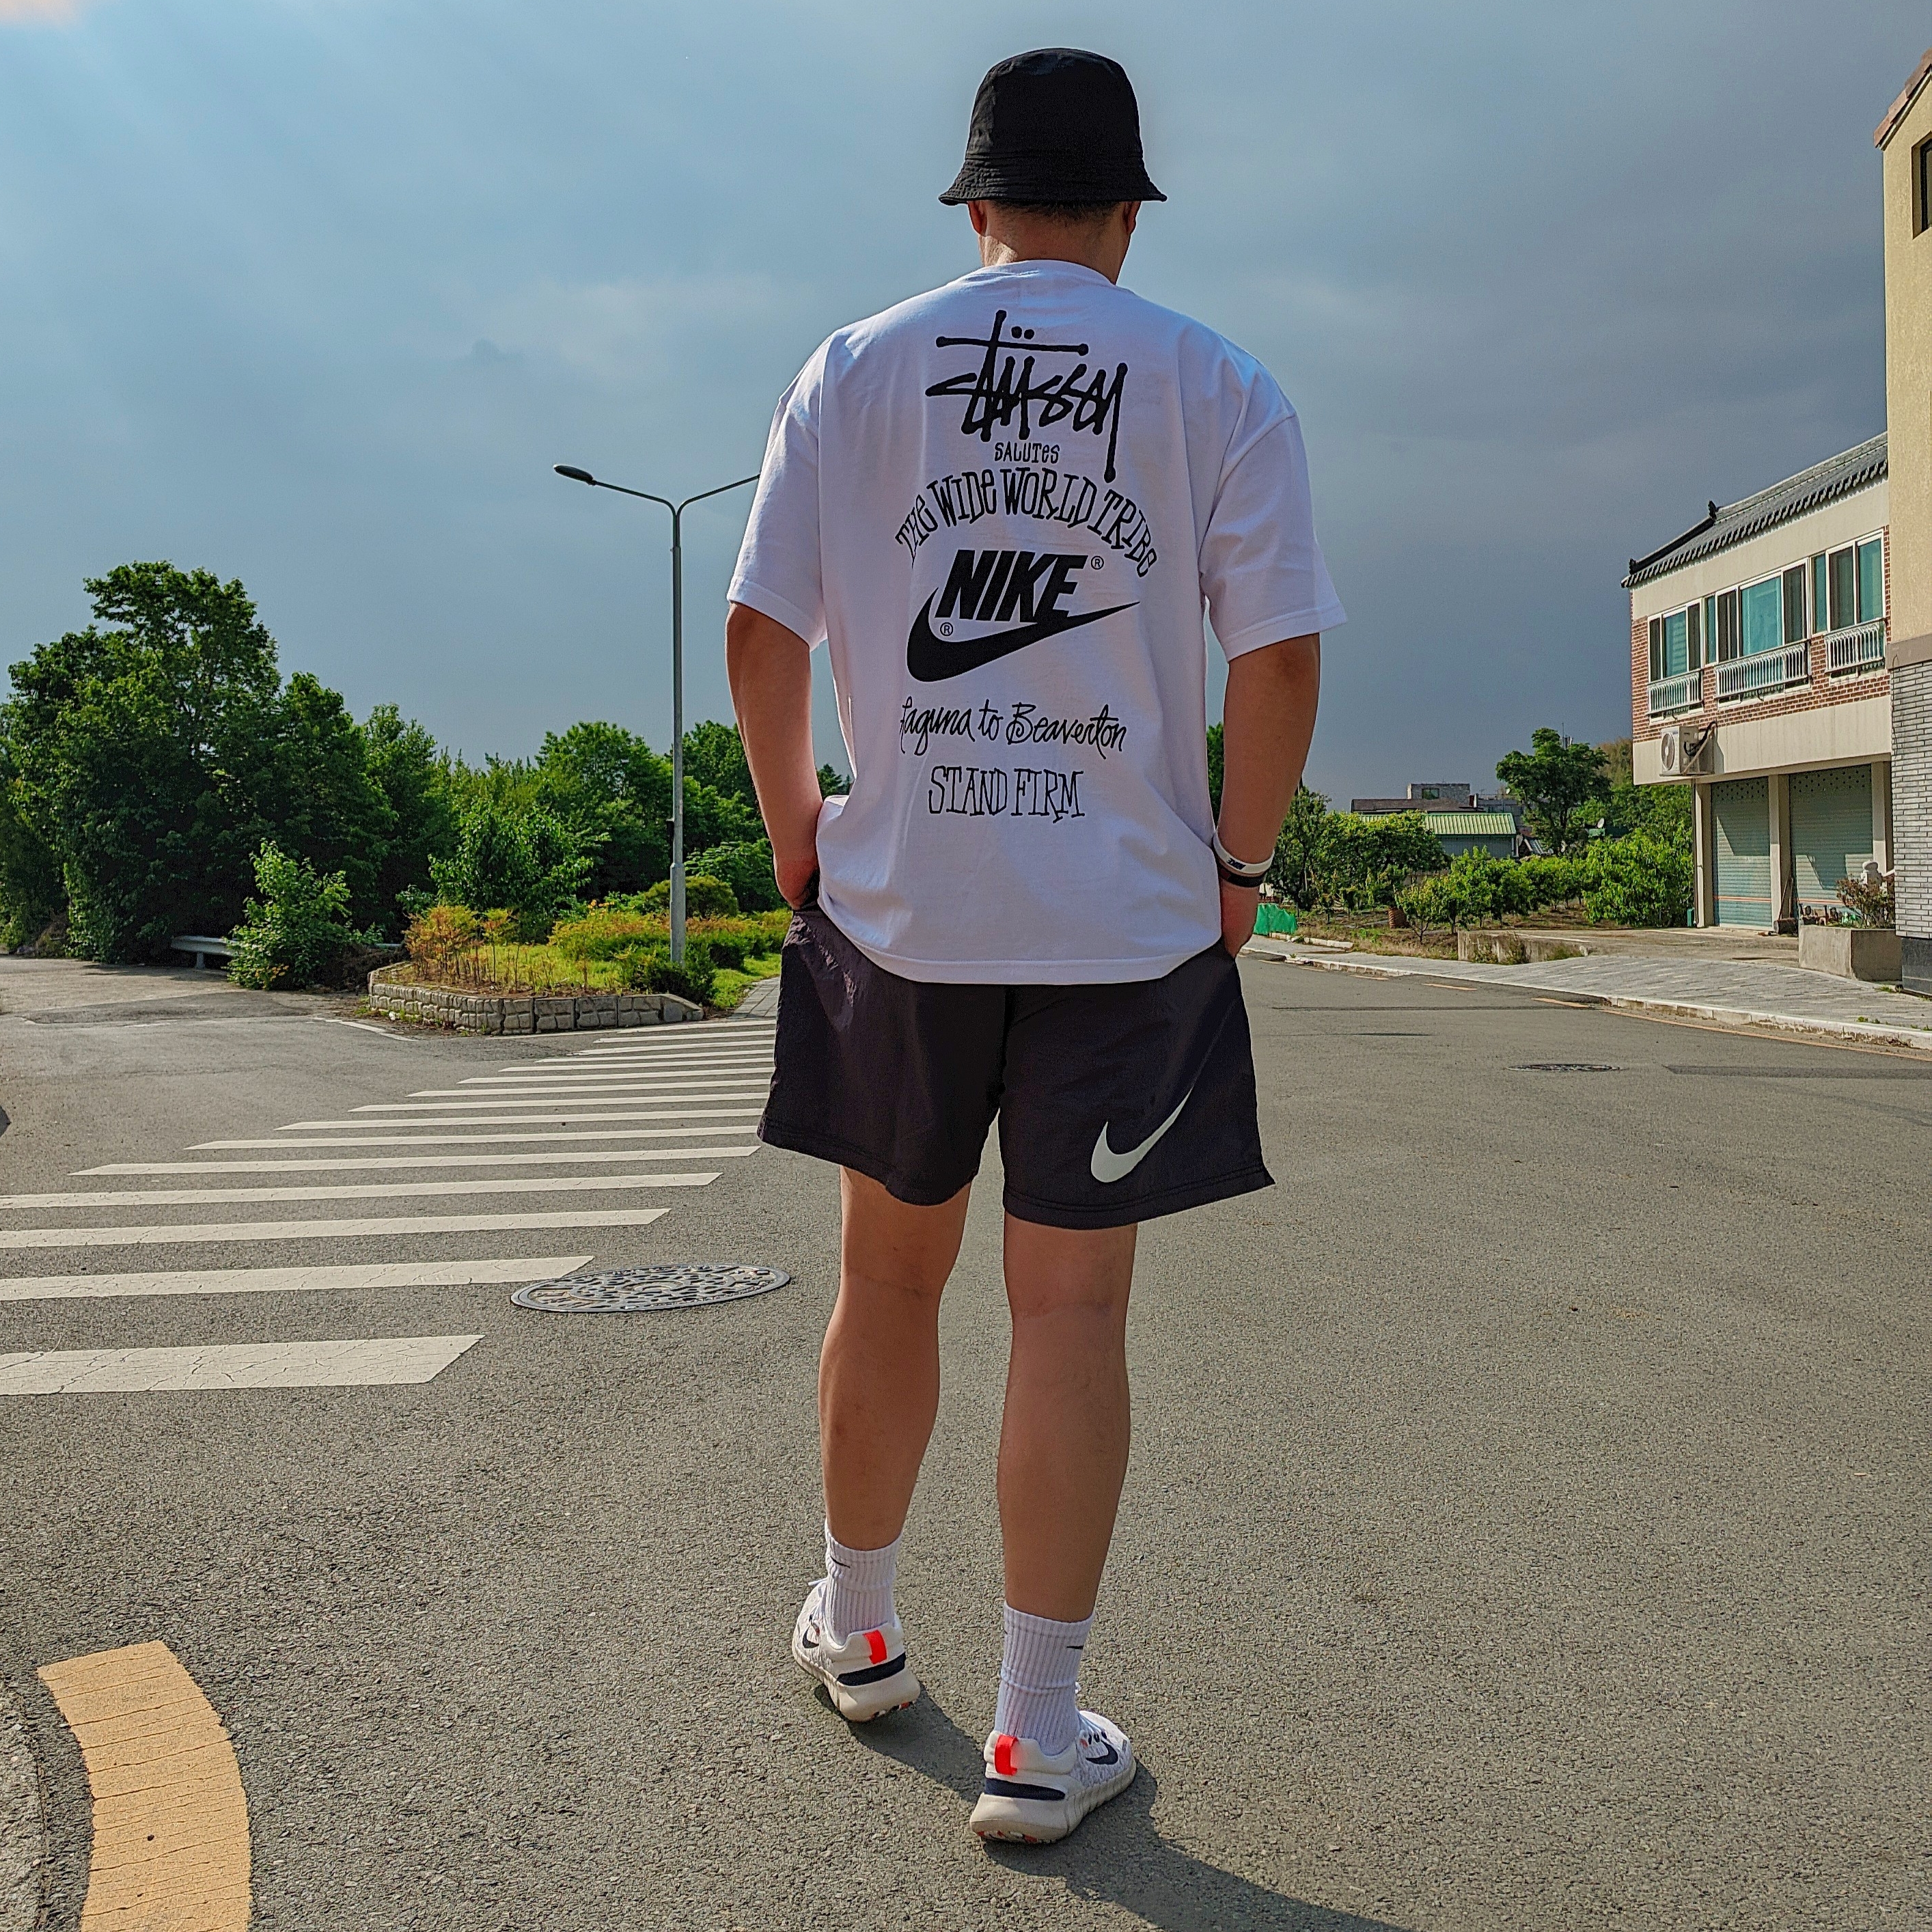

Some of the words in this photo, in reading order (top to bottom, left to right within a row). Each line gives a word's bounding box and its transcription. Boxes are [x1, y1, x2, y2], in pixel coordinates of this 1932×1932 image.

[999, 467, 1098, 529] WORLD
[935, 549, 1089, 623] NIKE
[977, 698, 1004, 741] to
[1005, 702, 1127, 760] Beaverton
[928, 765, 1008, 817] STAND
[1010, 768, 1086, 824] FIRM
